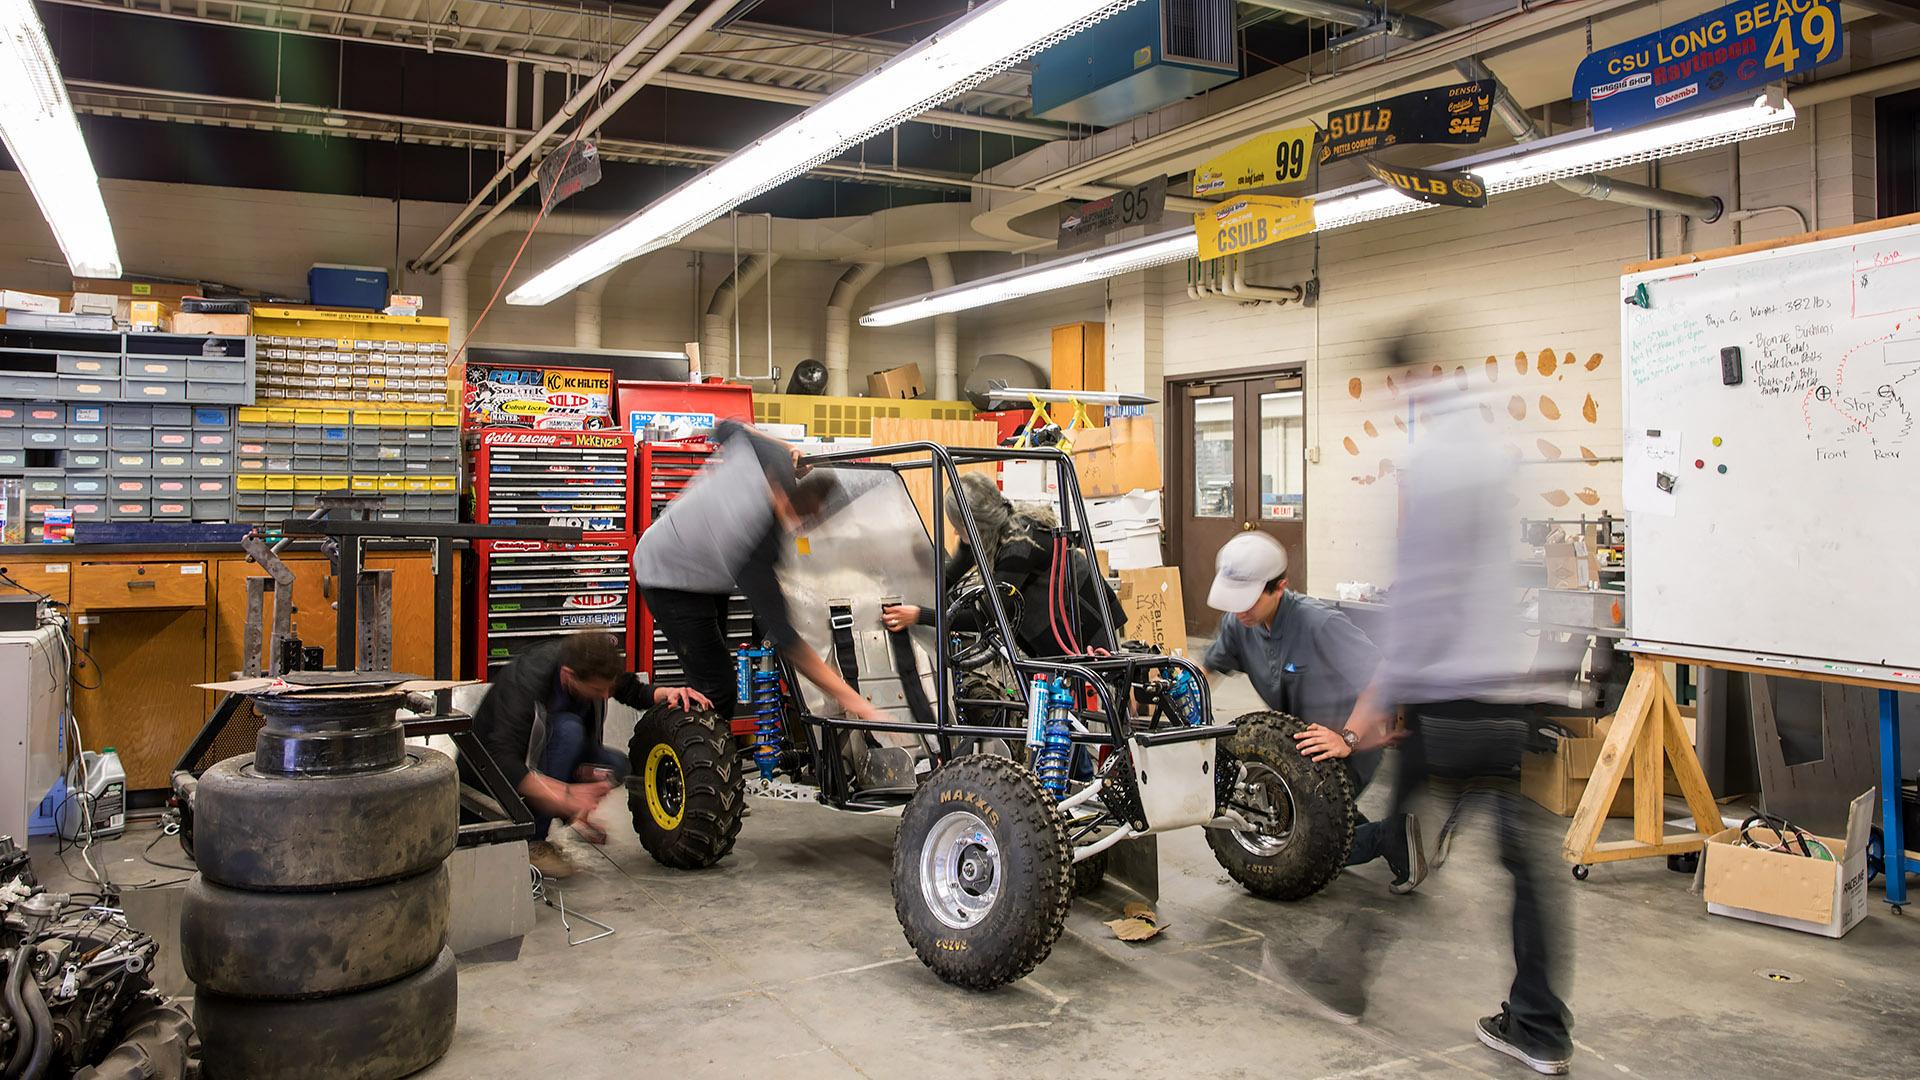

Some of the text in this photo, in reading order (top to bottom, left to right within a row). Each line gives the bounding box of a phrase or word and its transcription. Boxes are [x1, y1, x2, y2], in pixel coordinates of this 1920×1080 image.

[1607, 0, 1831, 75] CSU LONG BEAC
[1764, 5, 1836, 74] 49
[1653, 37, 1757, 87] Raytheon
[1448, 84, 1478, 97] DENSO
[1591, 75, 1652, 94] CHASSIS SHOP
[1665, 87, 1697, 104] brembo
[1448, 116, 1482, 135] SAE
[1275, 138, 1305, 182] 99
[1122, 186, 1149, 224] 95
[1217, 217, 1268, 253] CSULB
[547, 374, 562, 390] KC
[564, 378, 576, 388] KC
[546, 395, 589, 407] SOLID
[1843, 396, 1875, 414] Stop
[517, 434, 557, 444] RACING
[1816, 447, 1847, 462] Front
[571, 593, 618, 607] SOLID
[1154, 610, 1165, 651] BLICK
[940, 789, 999, 826] MAXXIS
